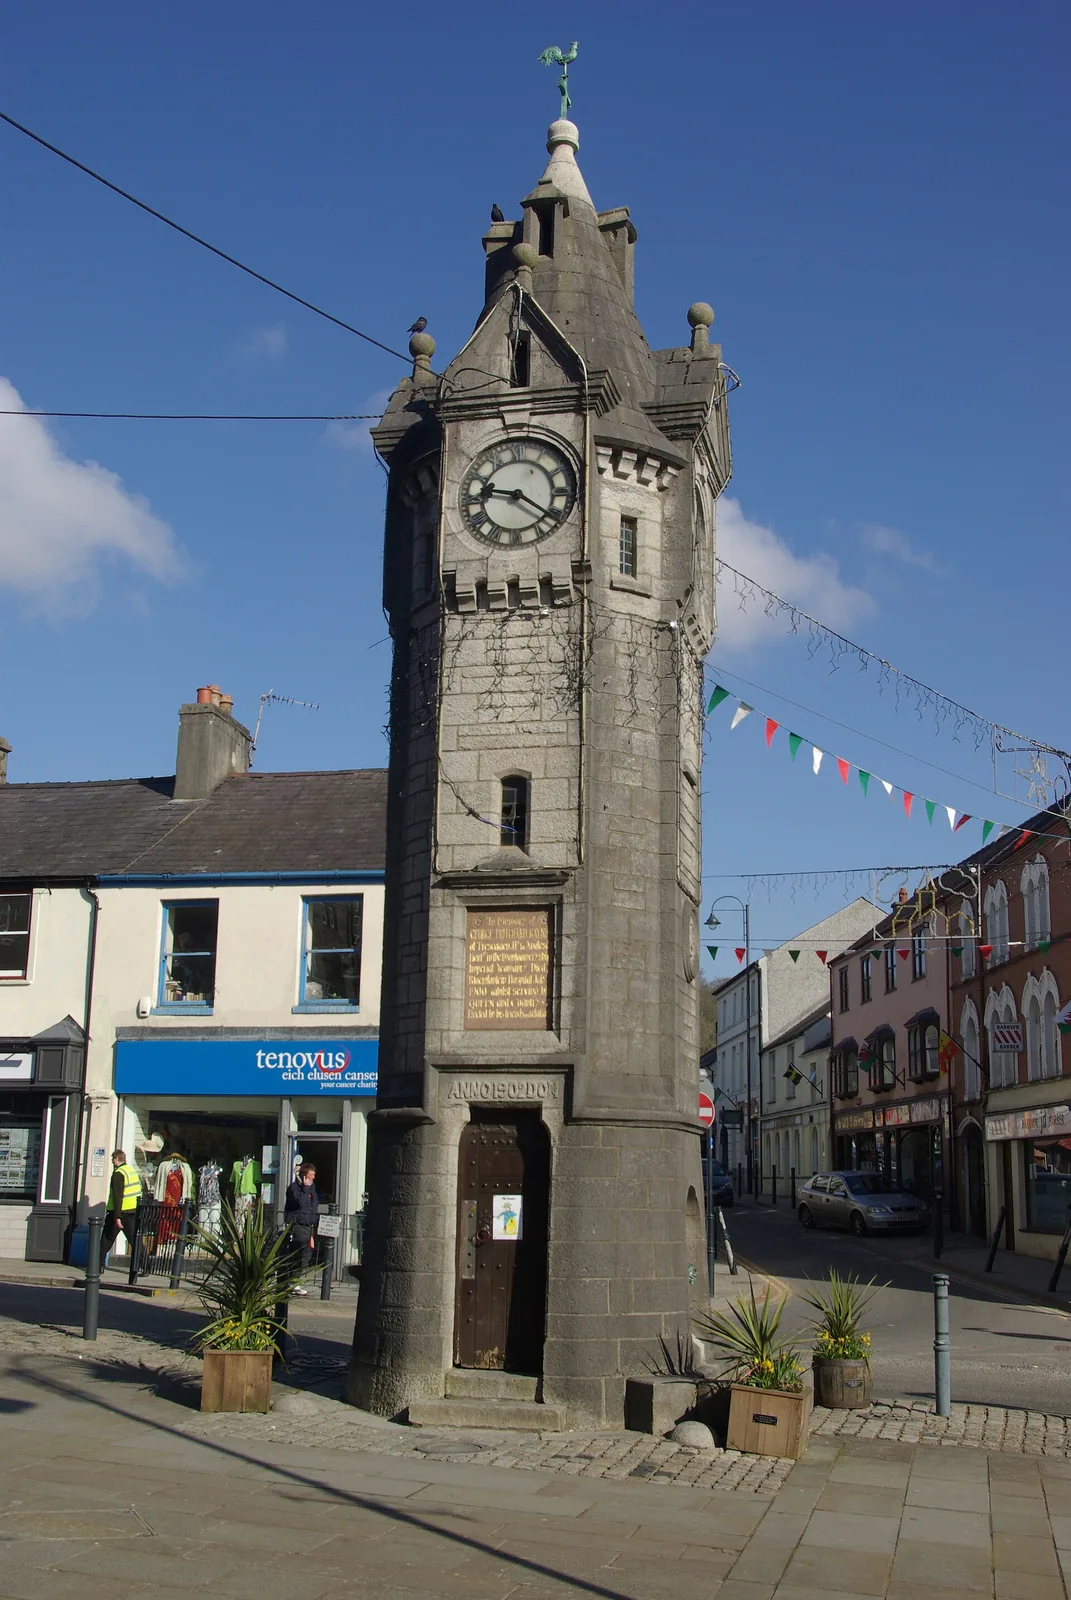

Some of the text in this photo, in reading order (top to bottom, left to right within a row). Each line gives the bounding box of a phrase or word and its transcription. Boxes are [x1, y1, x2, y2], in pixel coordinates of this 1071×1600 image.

[256, 1049, 346, 1069] tenovus
[282, 1068, 305, 1081] eich
[307, 1068, 341, 1081] elusen
[448, 1080, 559, 1099] ANNO 1902 DOM
